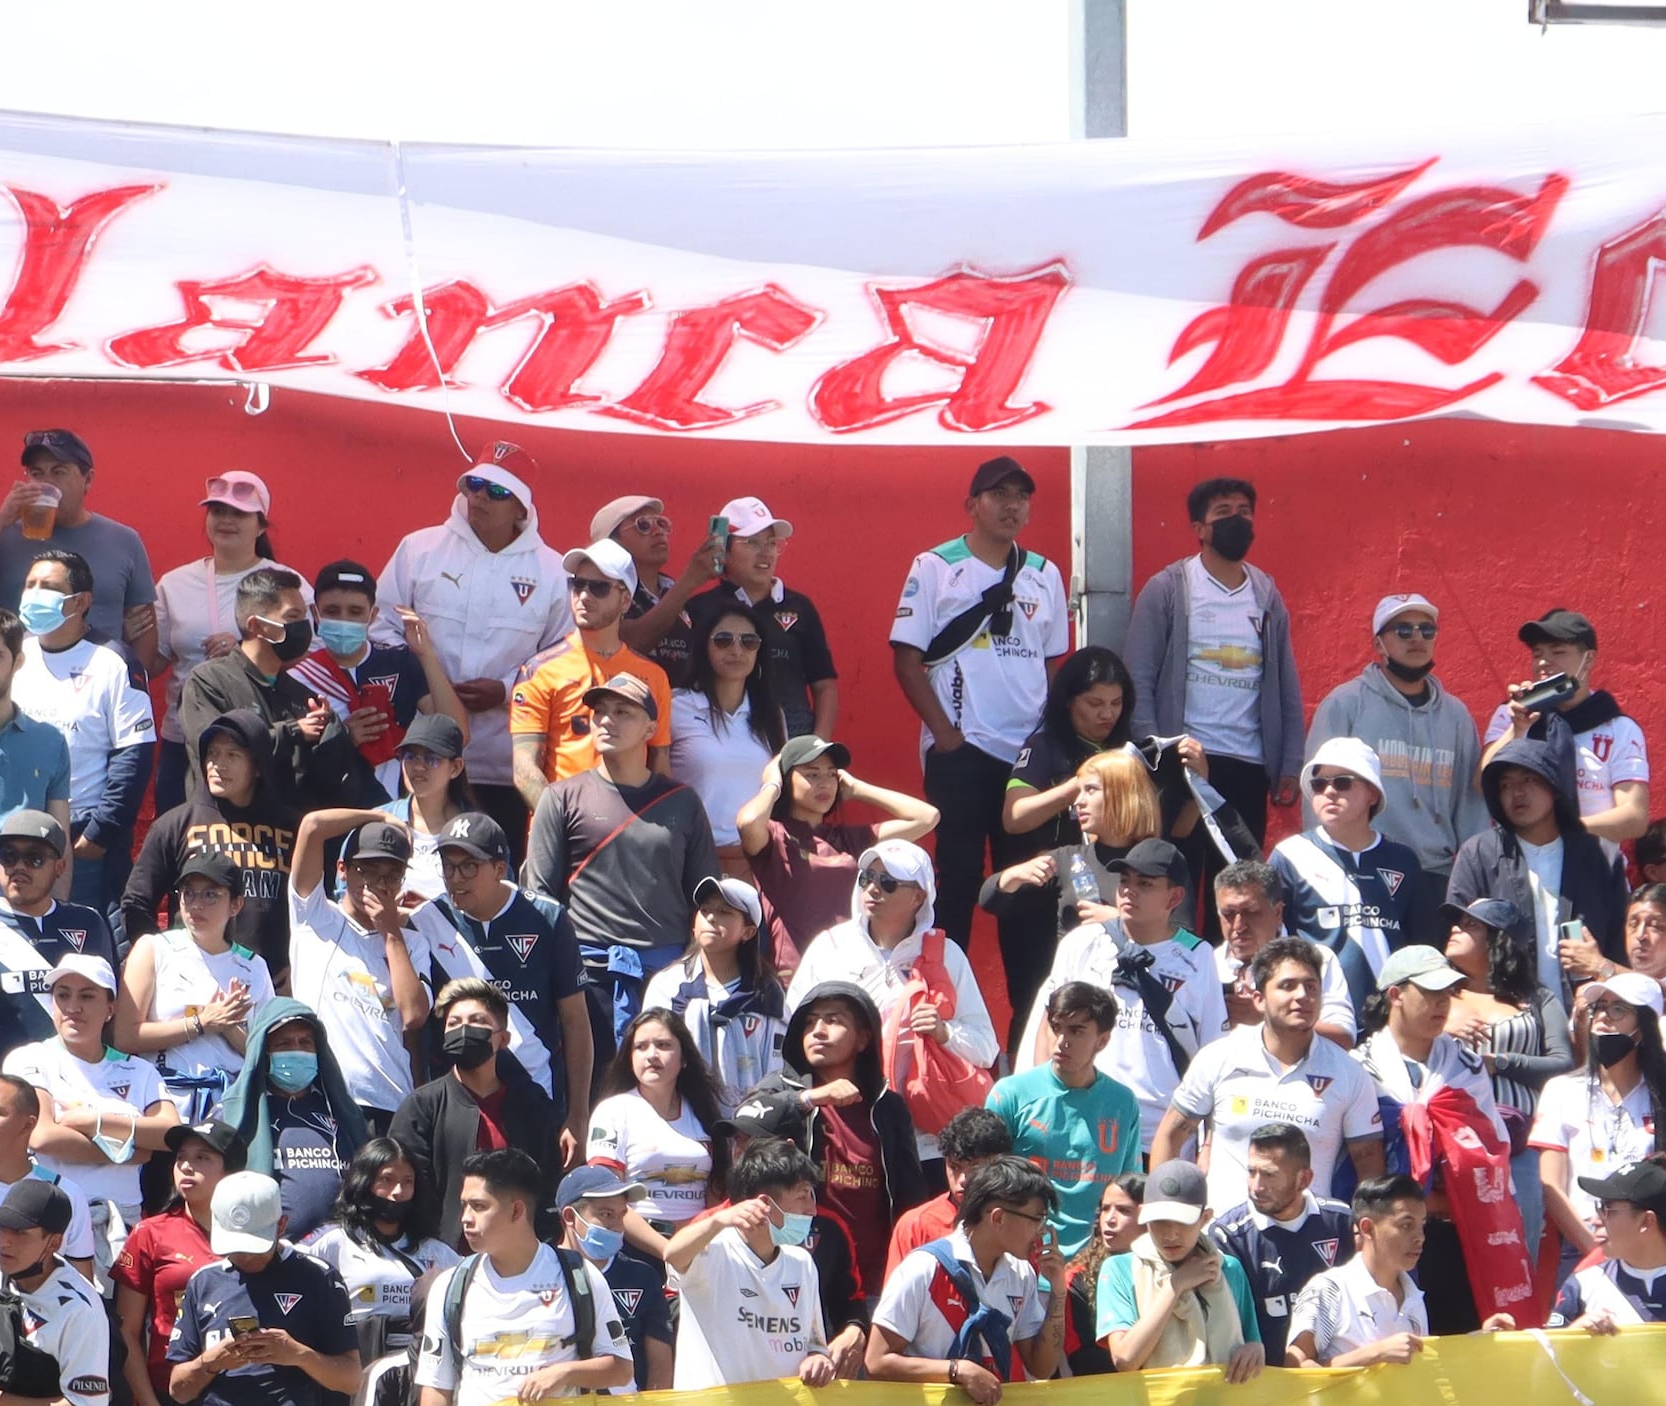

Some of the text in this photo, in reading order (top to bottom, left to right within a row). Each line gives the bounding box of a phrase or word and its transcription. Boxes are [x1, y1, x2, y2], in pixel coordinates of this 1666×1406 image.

[1254, 1098, 1297, 1111] BANCO
[1253, 1109, 1321, 1128] PICHINCHA
[286, 1147, 330, 1158] BANCO
[832, 1164, 872, 1174] BANCO
[737, 1306, 801, 1334] SIEMENS
